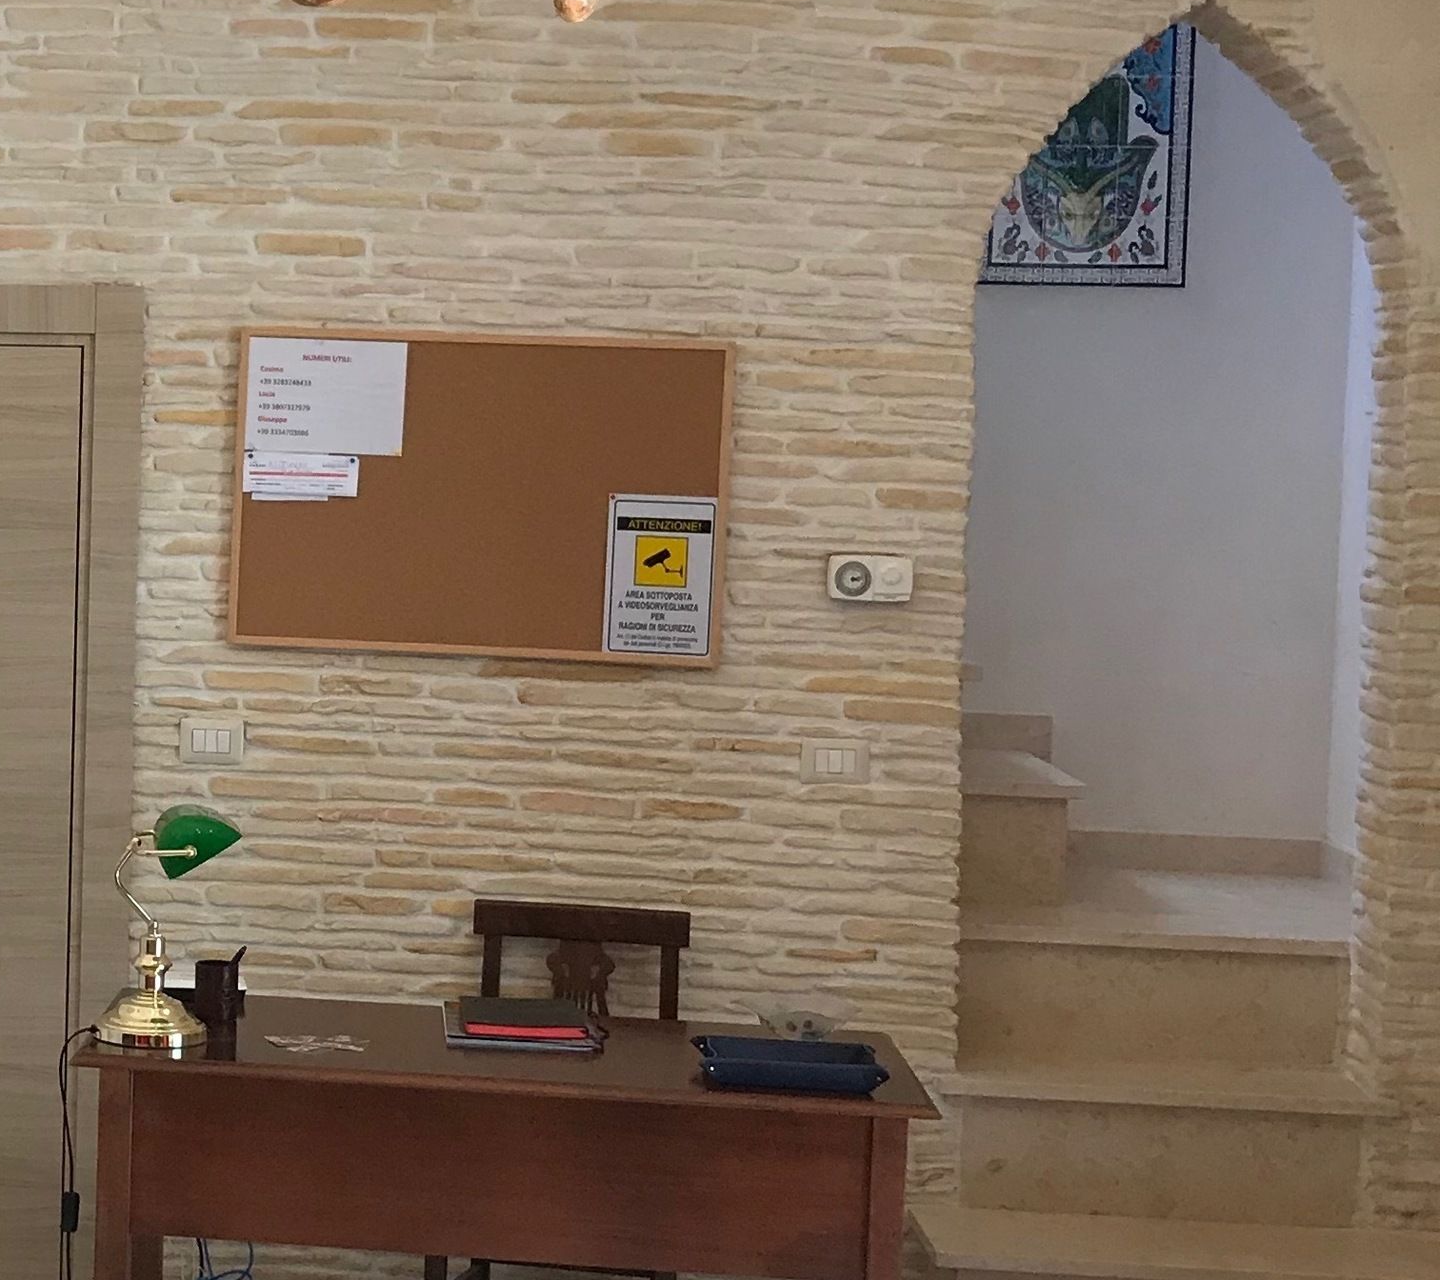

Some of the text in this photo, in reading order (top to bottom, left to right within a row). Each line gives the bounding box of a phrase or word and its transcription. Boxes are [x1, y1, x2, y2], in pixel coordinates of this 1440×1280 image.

[257, 415, 288, 423] Giuseppe
[627, 519, 702, 532] ATTENZIONE!
[625, 590, 693, 602] AREA SOTTOPOSTA
[617, 600, 699, 612] A VIDEOSORVEGLIANZA
[650, 612, 666, 621] PER
[618, 621, 697, 634] RAGIONI DI SICUREZZA
